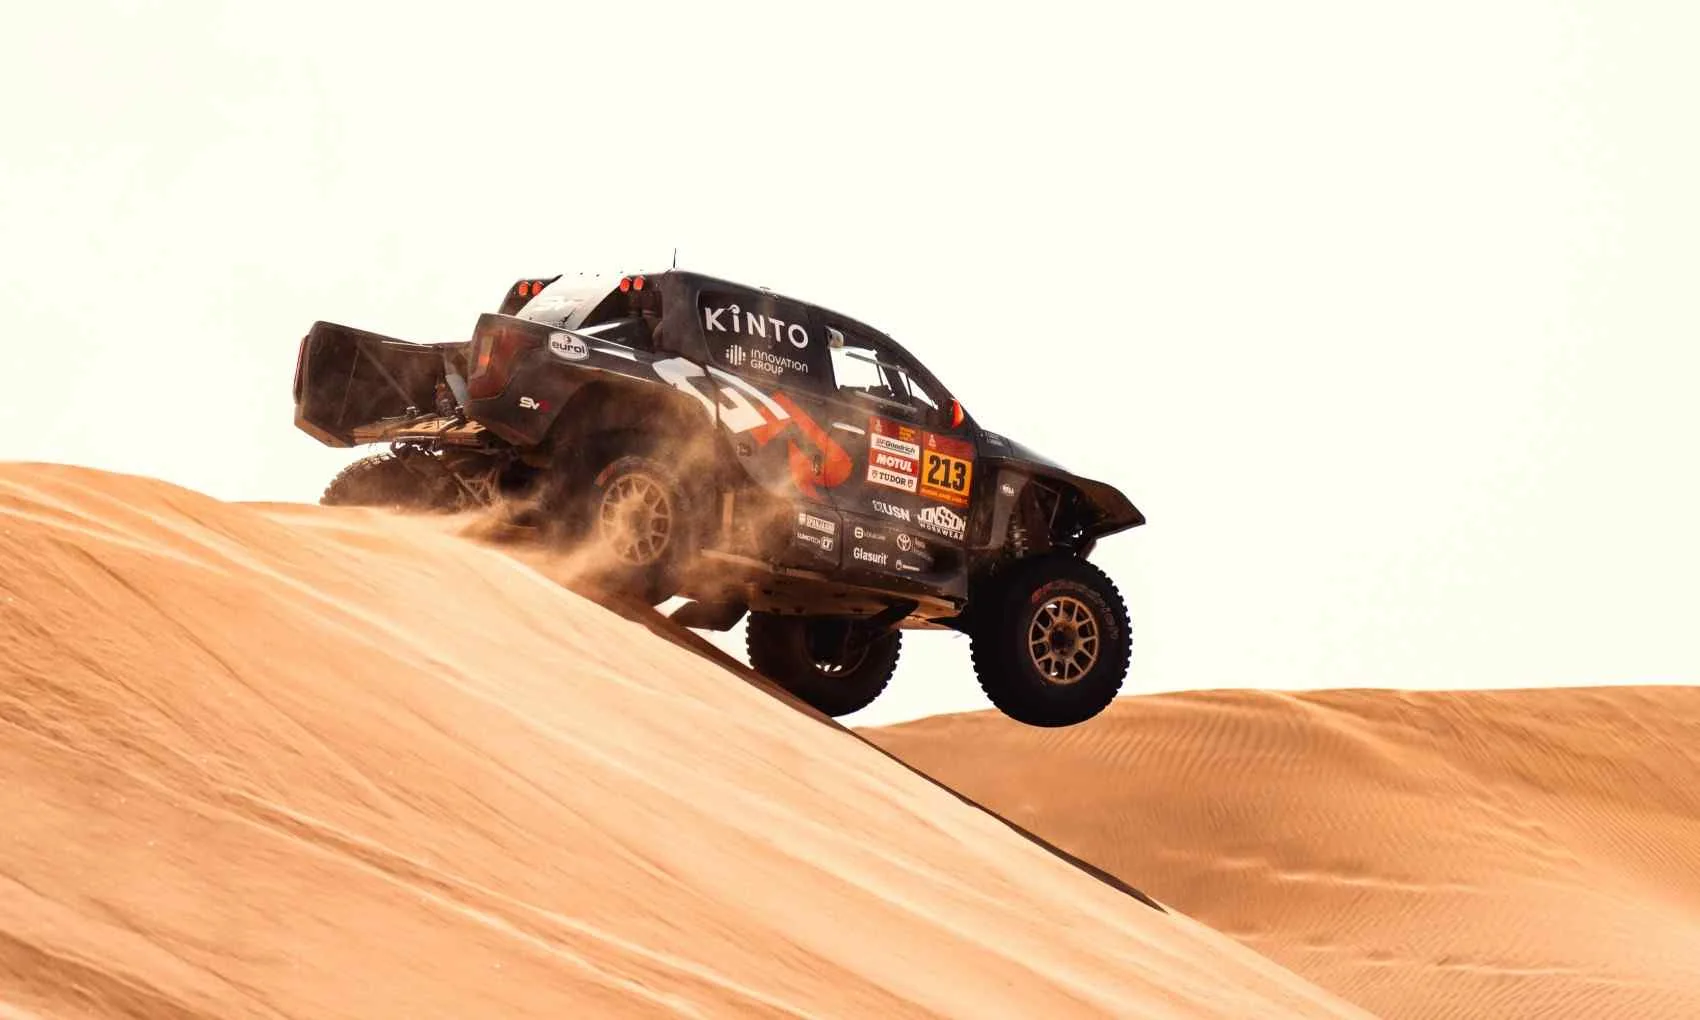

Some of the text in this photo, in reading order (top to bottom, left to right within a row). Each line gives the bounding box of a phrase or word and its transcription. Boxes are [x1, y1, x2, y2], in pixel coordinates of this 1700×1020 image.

[551, 341, 586, 354] eurol
[751, 359, 784, 376] GROUP
[876, 453, 913, 473] MOTUL
[879, 472, 906, 486] TUDOR
[927, 454, 967, 492] 213
[881, 500, 911, 522] USN
[917, 505, 966, 531] JONSSON
[918, 521, 964, 540] WORKWEAR
[853, 547, 888, 566] Glasurit
